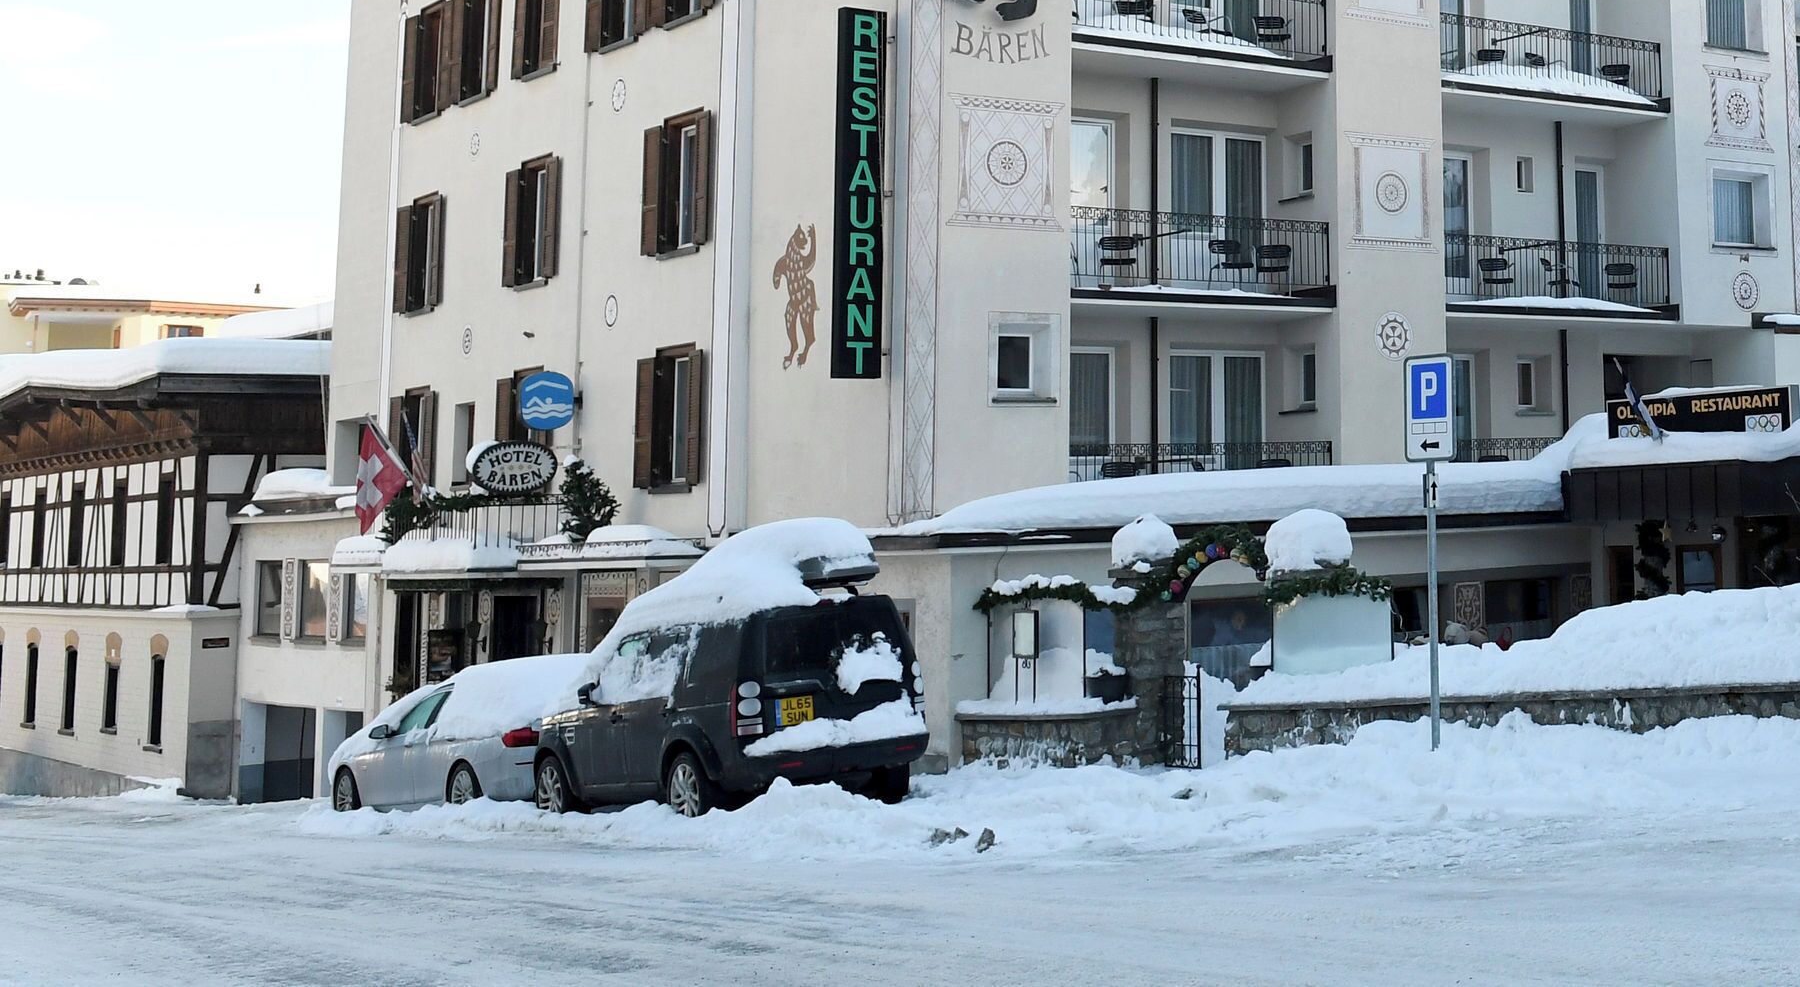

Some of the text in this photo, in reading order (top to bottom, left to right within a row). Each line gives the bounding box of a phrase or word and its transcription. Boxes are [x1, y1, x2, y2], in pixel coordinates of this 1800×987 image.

[950, 20, 1050, 63] BÄREN
[846, 13, 879, 375] RESTAURANT
[1420, 371, 1437, 411] P
[1616, 393, 1781, 420] OLPIA RESTAURANT
[489, 450, 542, 468] HOTEL
[782, 697, 811, 711] JL65
[786, 710, 809, 723] SUN
